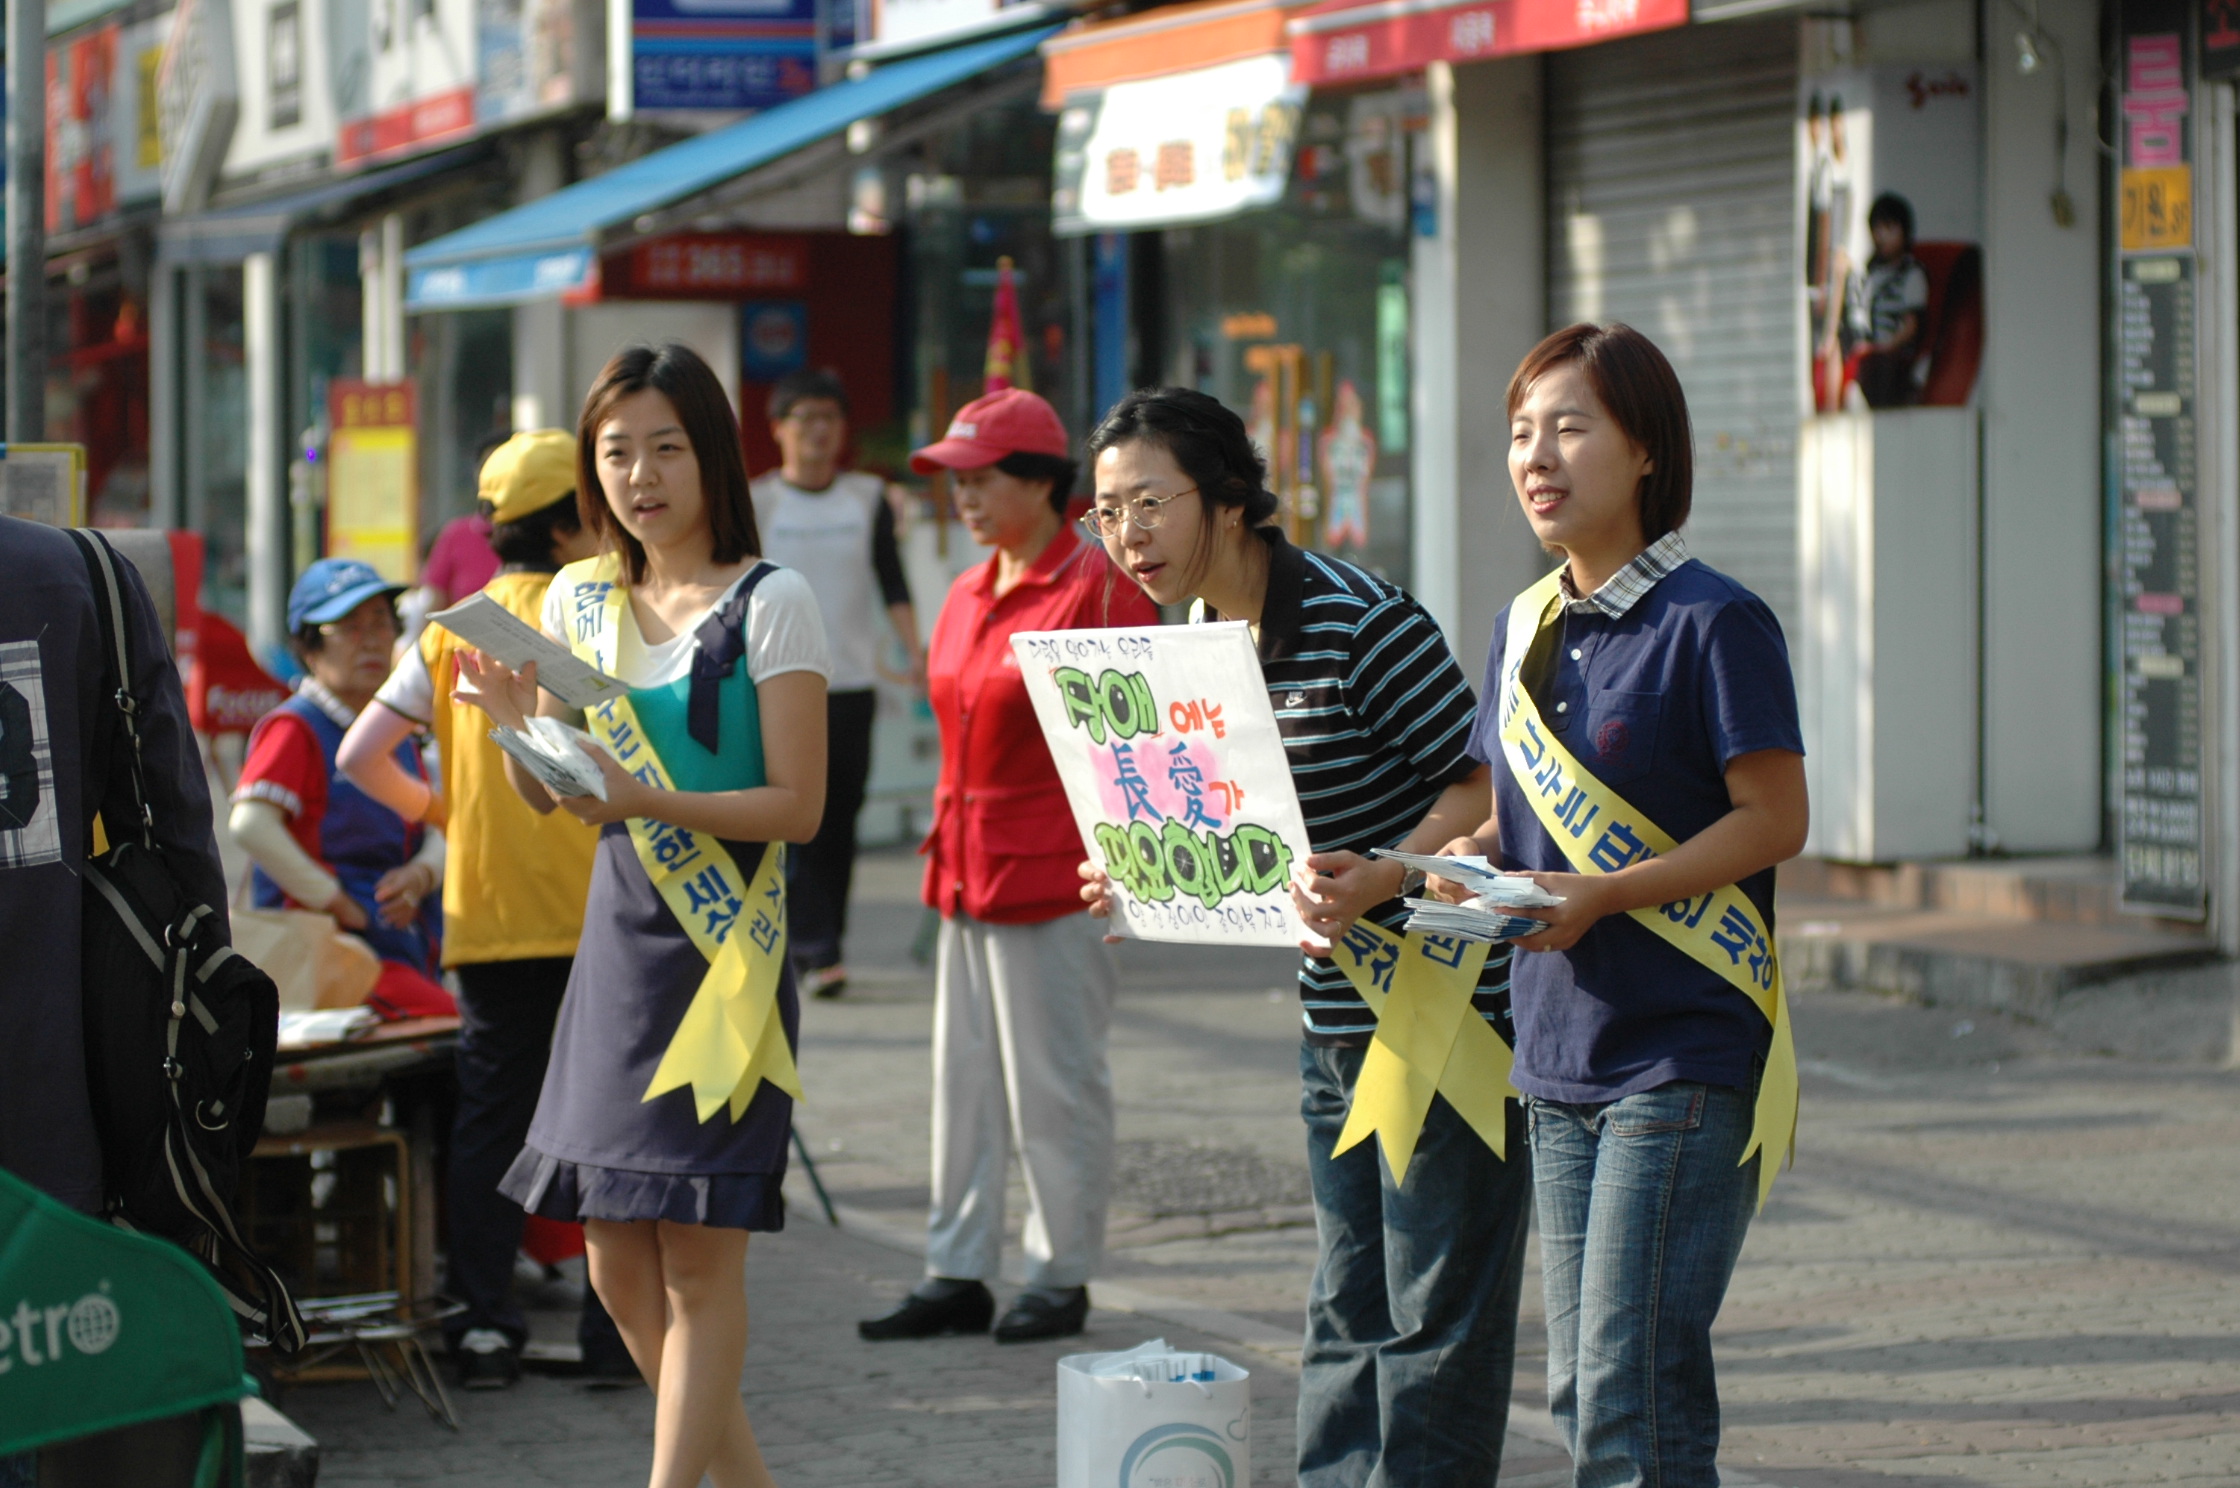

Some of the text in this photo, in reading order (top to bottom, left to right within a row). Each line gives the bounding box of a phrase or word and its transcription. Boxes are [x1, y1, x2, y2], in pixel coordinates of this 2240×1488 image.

[574, 581, 615, 645] 함께
[1519, 717, 1600, 840] 나누는
[682, 863, 743, 945] 세상
[1094, 816, 1295, 910] 필요합니다
[1587, 820, 1715, 930] 따한
[1340, 923, 1401, 994] 세상
[1709, 903, 1773, 992] 세상
